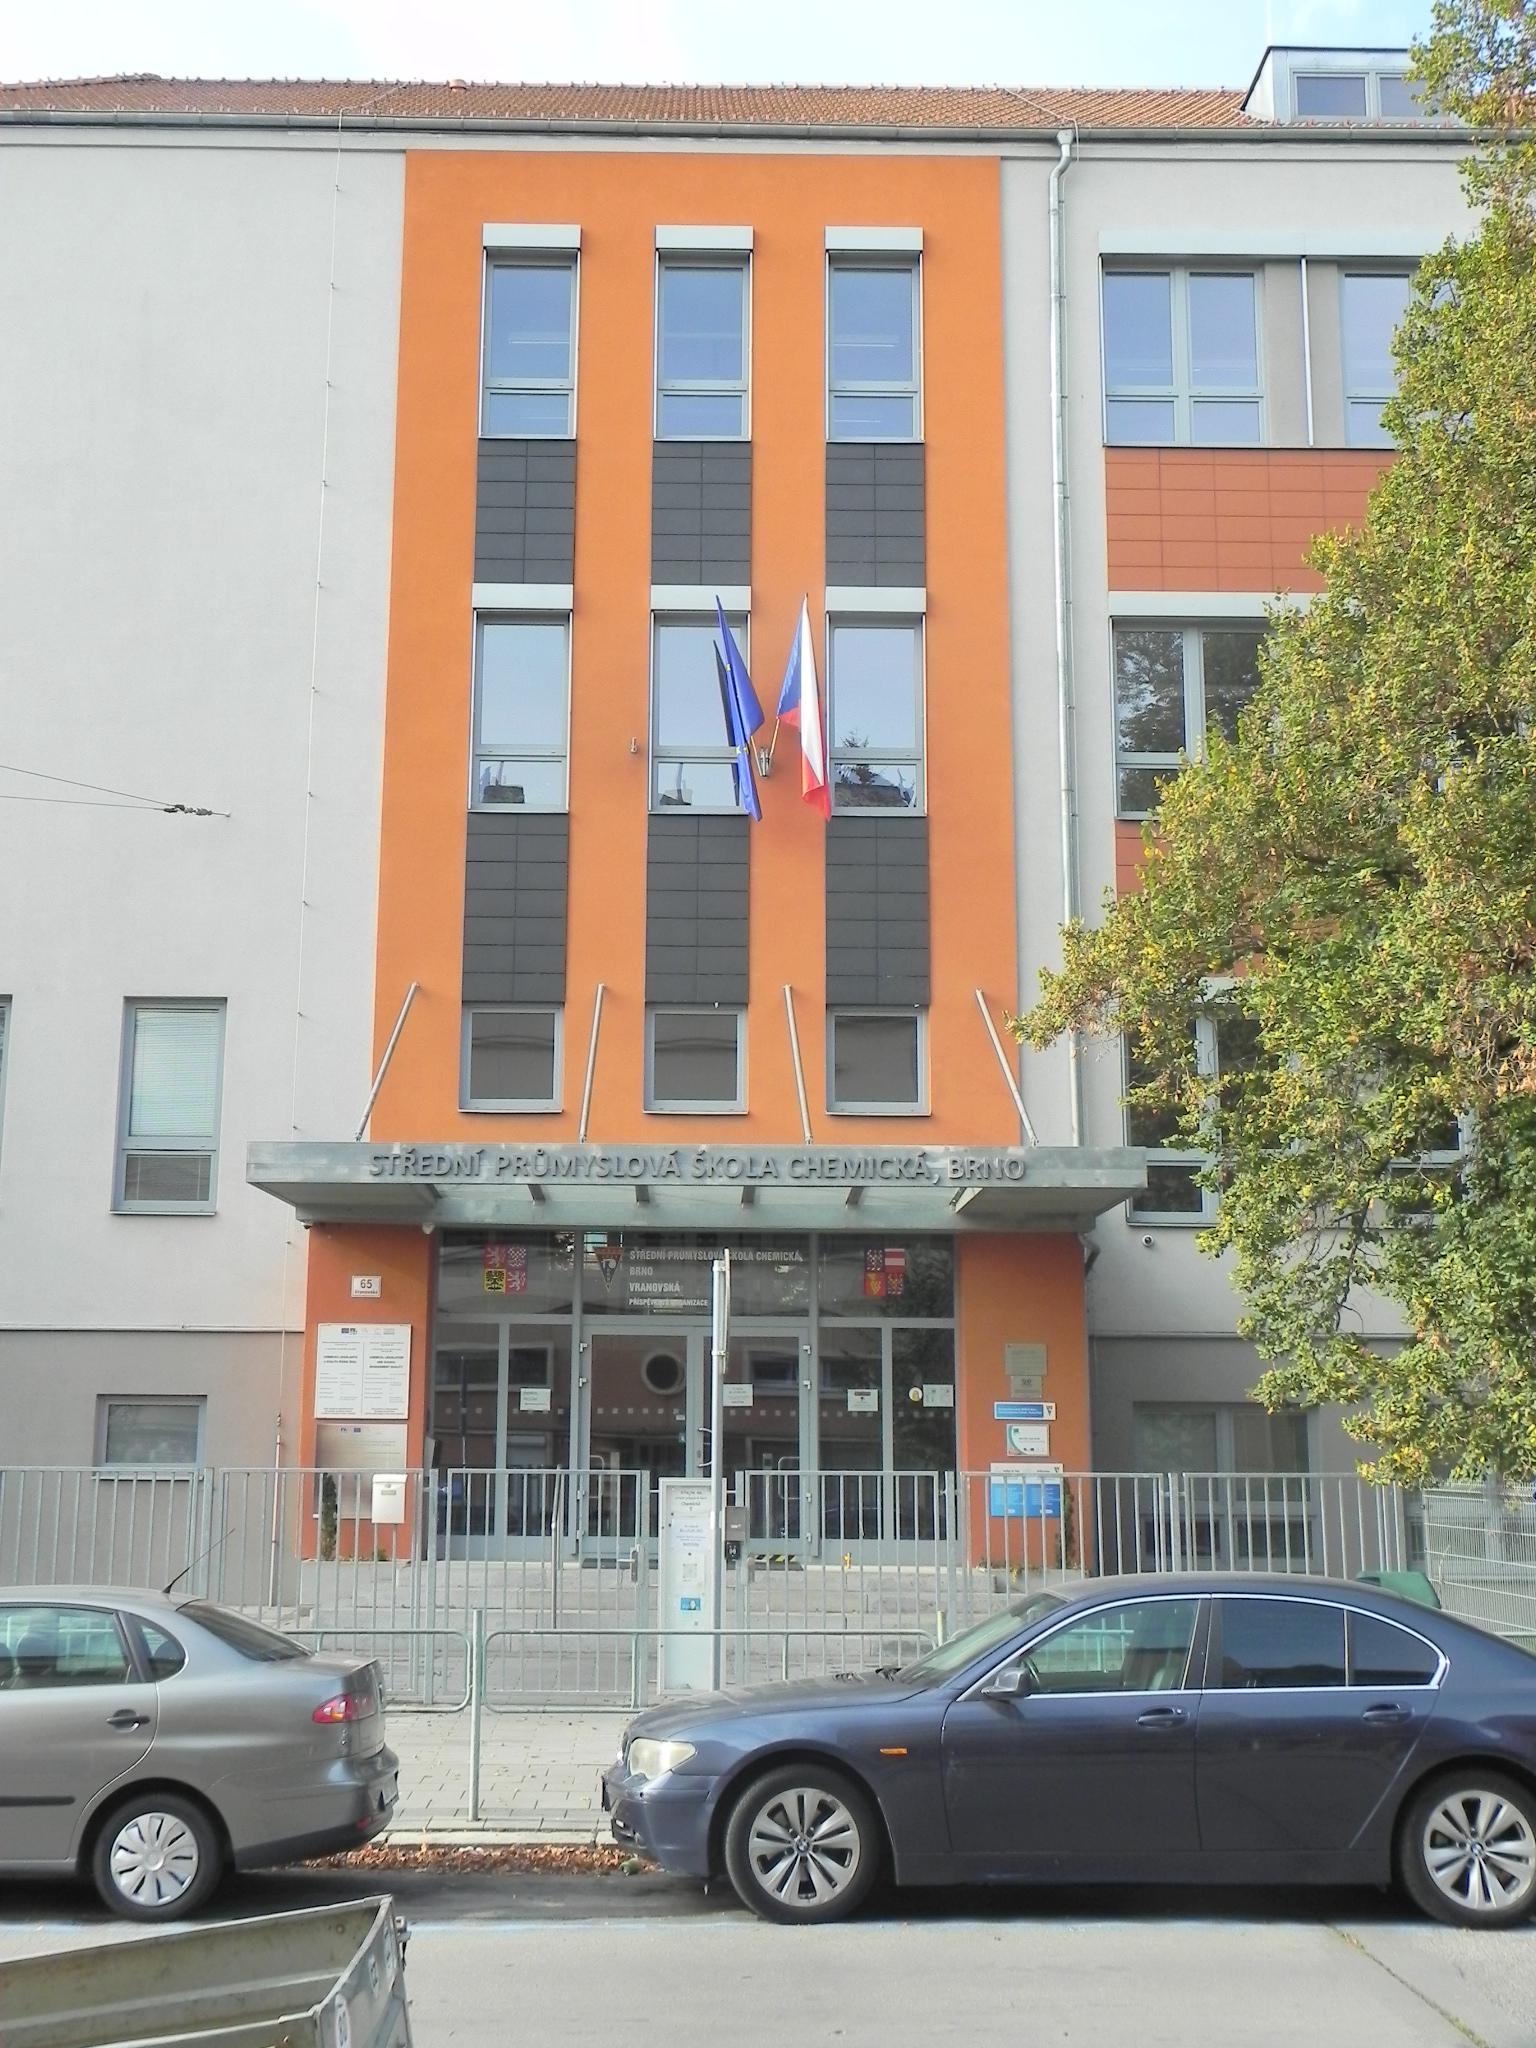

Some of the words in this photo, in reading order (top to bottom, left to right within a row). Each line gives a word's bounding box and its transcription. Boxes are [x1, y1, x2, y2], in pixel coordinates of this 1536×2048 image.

[369, 1149, 485, 1178] STŘEDNÍ
[496, 1148, 681, 1179] PRŮMYSLOVÁ
[691, 1150, 779, 1180] ŠKOLA
[786, 1152, 940, 1185] CHEMICKÁ,
[946, 1155, 1026, 1181] BRNO
[629, 1248, 666, 1260] STŘEDNÍ
[725, 1249, 754, 1261] KOLA
[629, 1266, 653, 1276] BRNO
[360, 1279, 373, 1289] 65
[629, 1281, 680, 1292] VRANOVSKÁ
